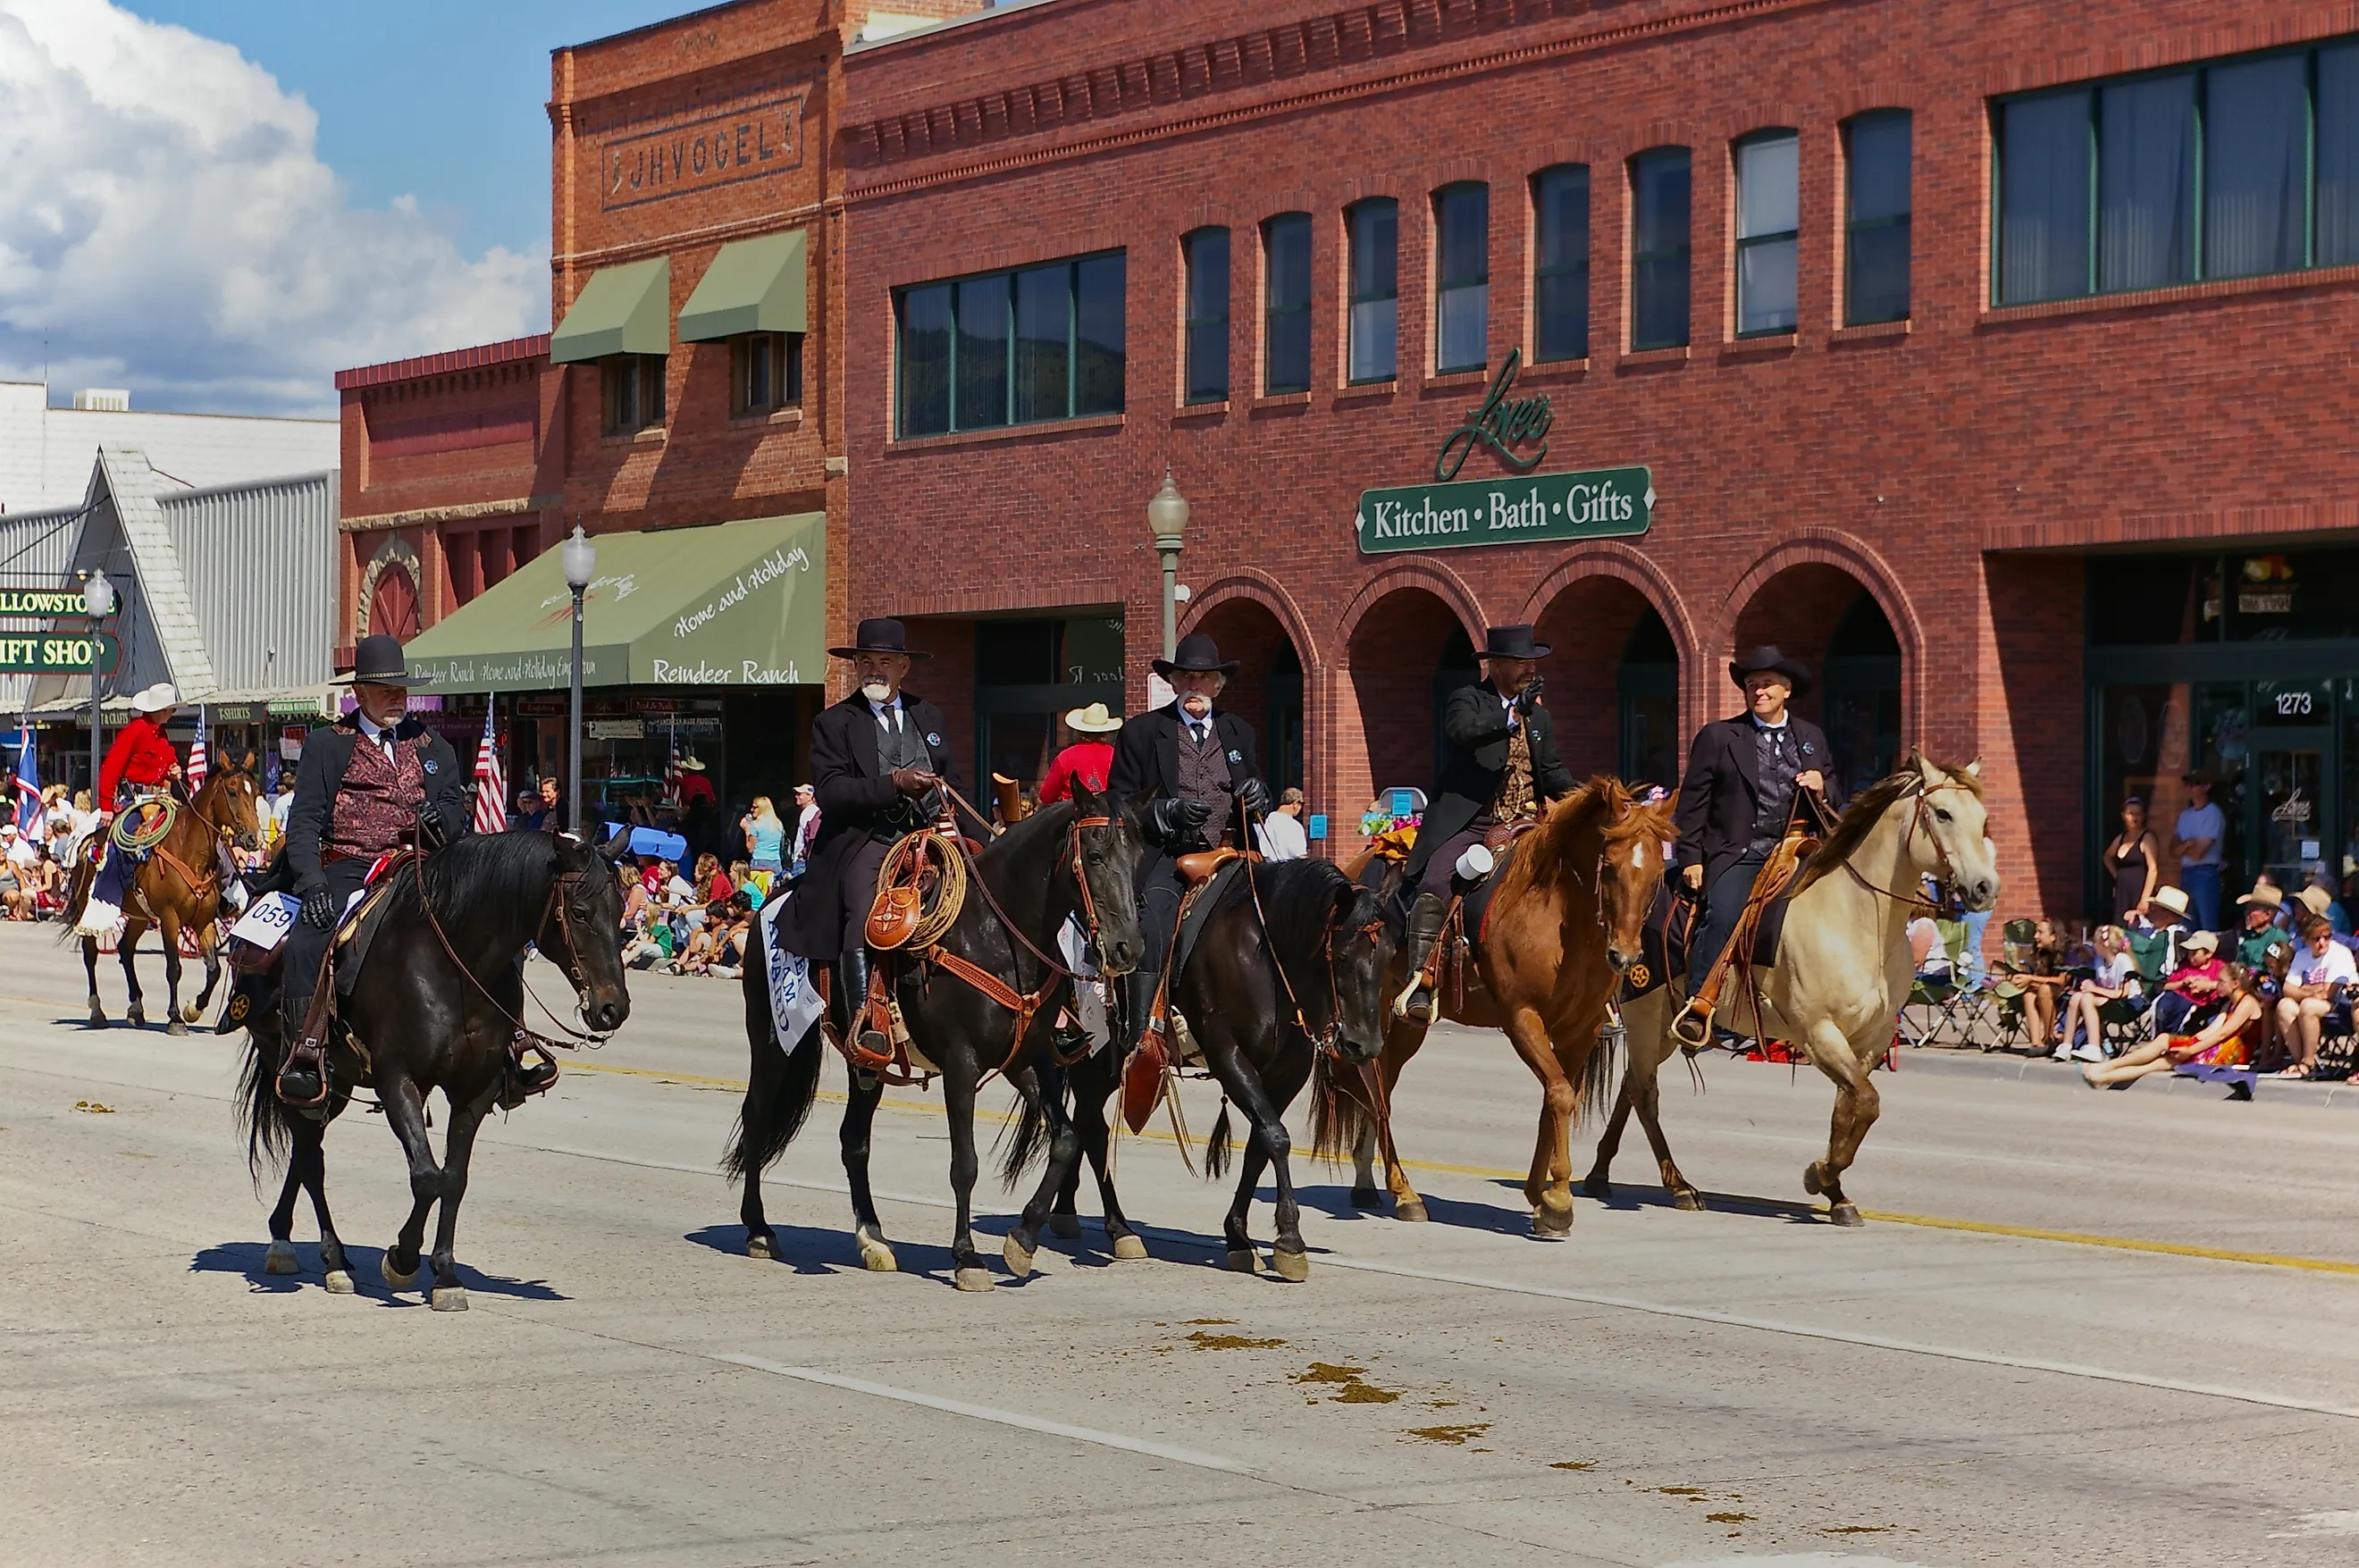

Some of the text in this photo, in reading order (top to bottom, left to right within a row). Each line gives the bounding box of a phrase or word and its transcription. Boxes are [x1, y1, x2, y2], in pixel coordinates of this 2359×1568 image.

[1373, 480, 1633, 539] Kitchen Bath Gifts
[0, 592, 115, 613] LLOWSTO
[674, 547, 809, 638] Home and Holiday
[450, 661, 474, 682] Ranch
[522, 655, 555, 689] Holiday
[653, 659, 800, 684] Reindeer Ranch
[217, 707, 251, 720] T-SHIRTS
[2275, 692, 2312, 715] 1273
[252, 903, 293, 927] 059
